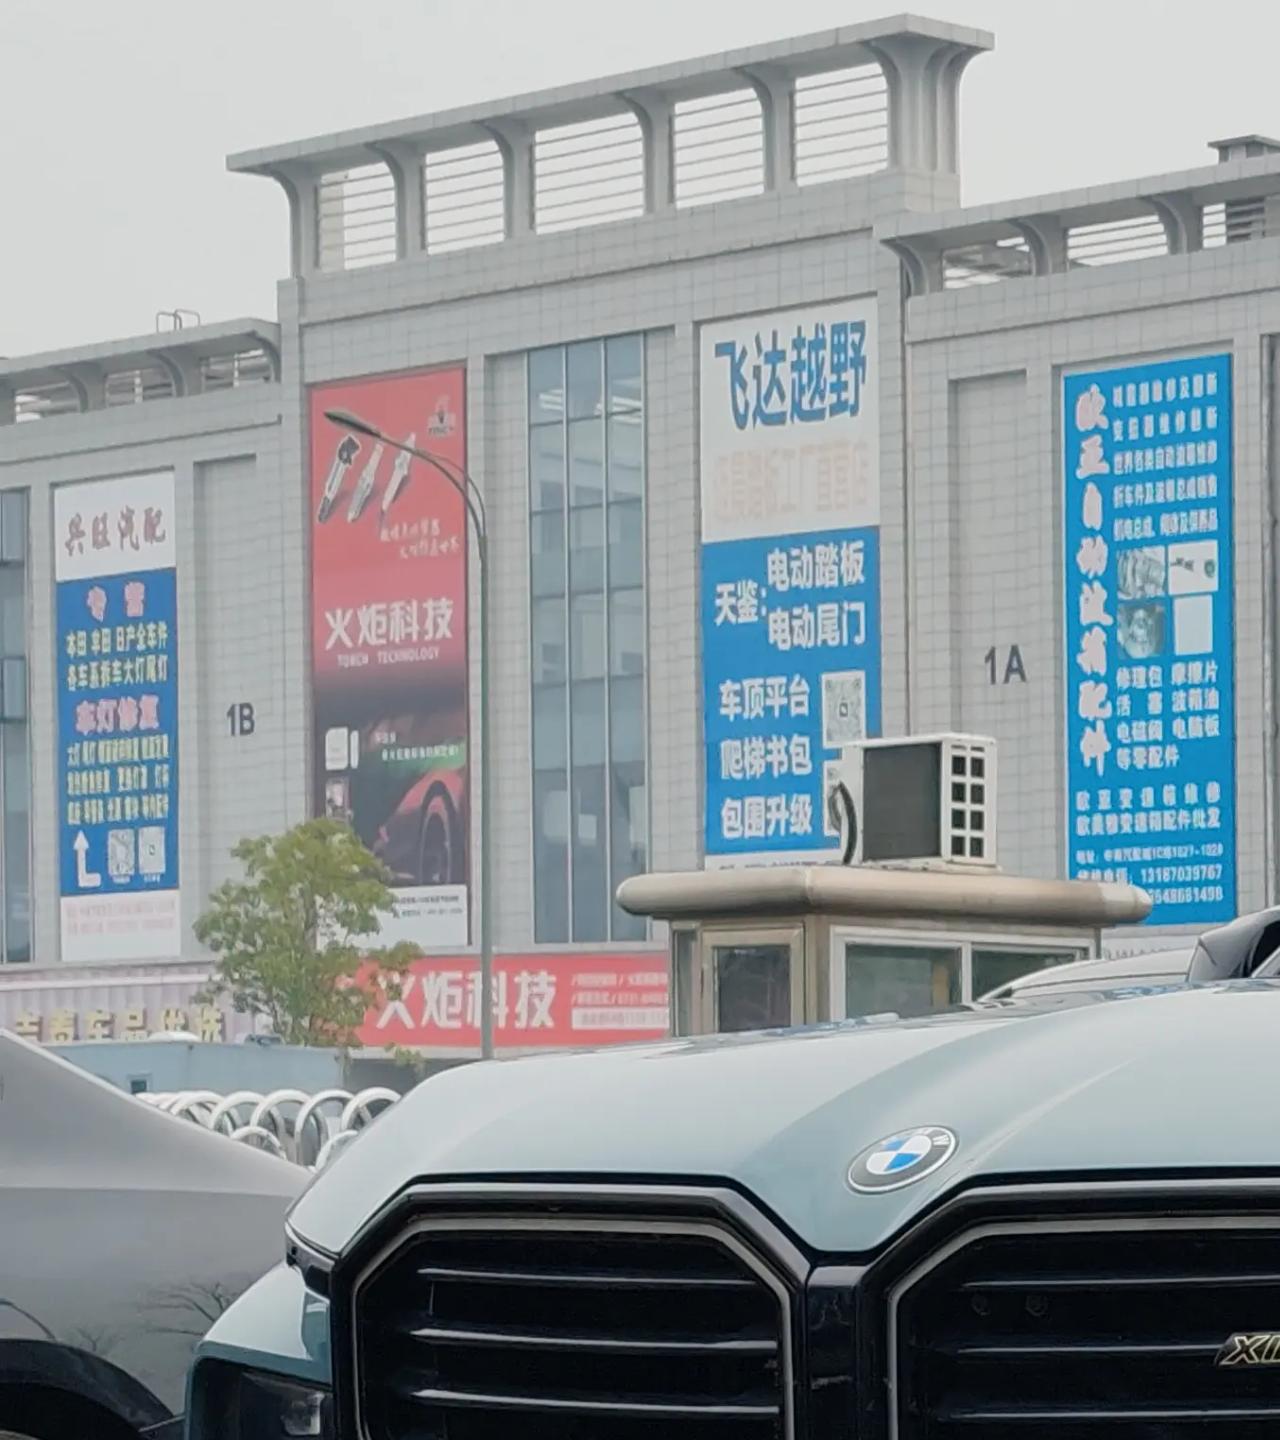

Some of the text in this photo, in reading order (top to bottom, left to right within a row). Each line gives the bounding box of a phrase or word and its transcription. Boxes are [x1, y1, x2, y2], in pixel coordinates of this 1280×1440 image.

[714, 318, 867, 431] 飞达越野
[766, 539, 866, 592] 电动踏板
[324, 596, 454, 651] 火炬科技
[767, 601, 866, 651] 电动尾门
[337, 646, 440, 669] TORCH TECHNOLOGY
[984, 644, 1027, 686] 1A
[226, 702, 255, 737] 1B
[718, 672, 811, 723] 车顶平台
[719, 732, 812, 781] 爬梯书包
[720, 793, 813, 841] 包围升级
[1140, 864, 1222, 885] 13187039767
[376, 969, 557, 1030] 火炬科技
